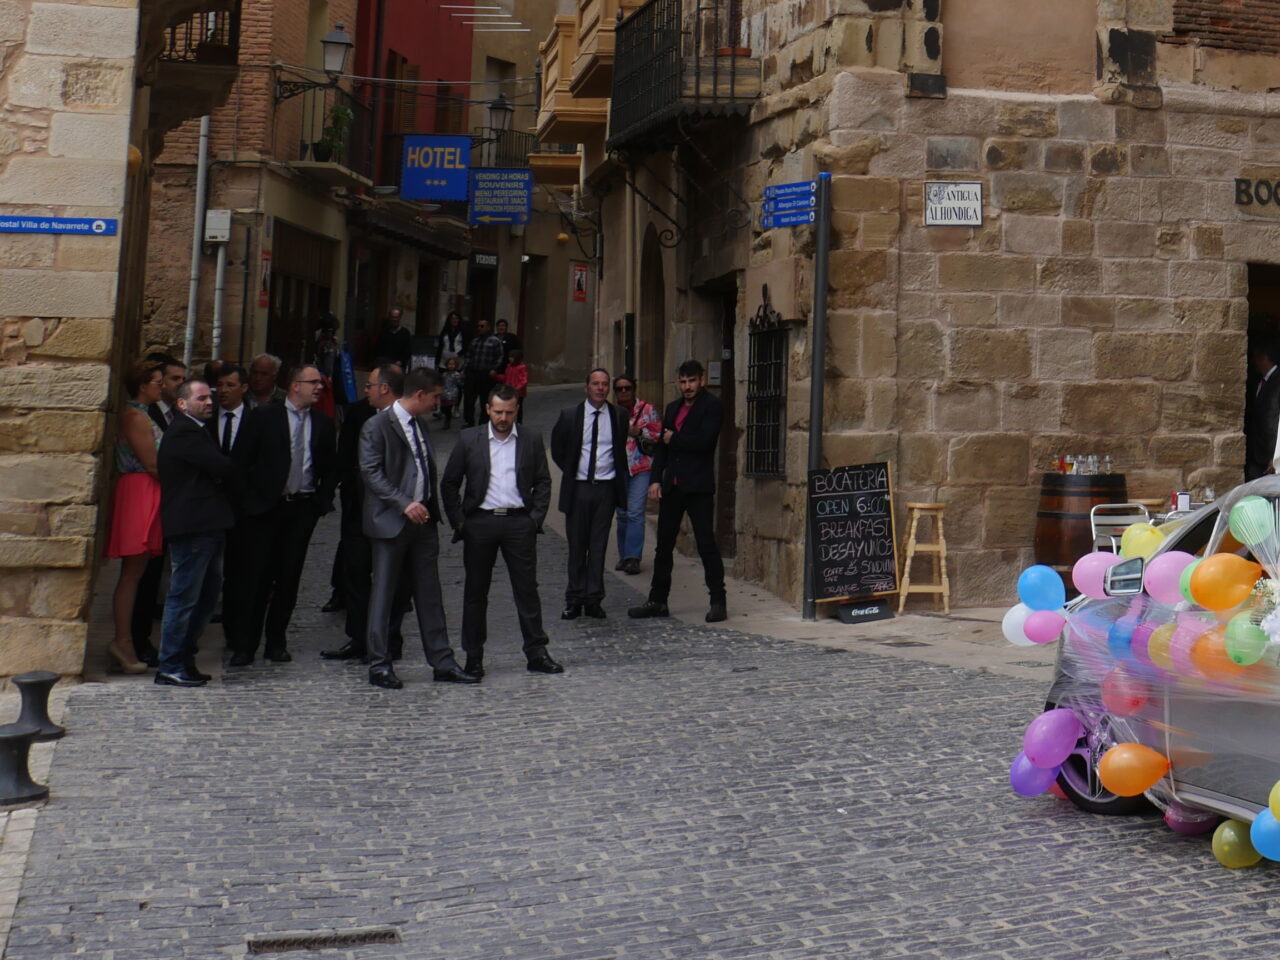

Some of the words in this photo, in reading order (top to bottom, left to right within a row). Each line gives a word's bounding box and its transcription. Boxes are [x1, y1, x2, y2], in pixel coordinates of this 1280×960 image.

[407, 147, 466, 169] HOTEL
[945, 189, 980, 202] ANTIGUA
[928, 205, 980, 221] ALHONDIGA
[0, 220, 20, 228] ostal
[21, 221, 39, 229] Villa
[40, 221, 50, 230] de
[52, 222, 90, 231] Navarrete
[812, 468, 887, 493] BOCATERIA
[816, 498, 850, 516] OPEN
[818, 517, 890, 541] BREAKFAST
[818, 538, 893, 562] DESAYUNOS
